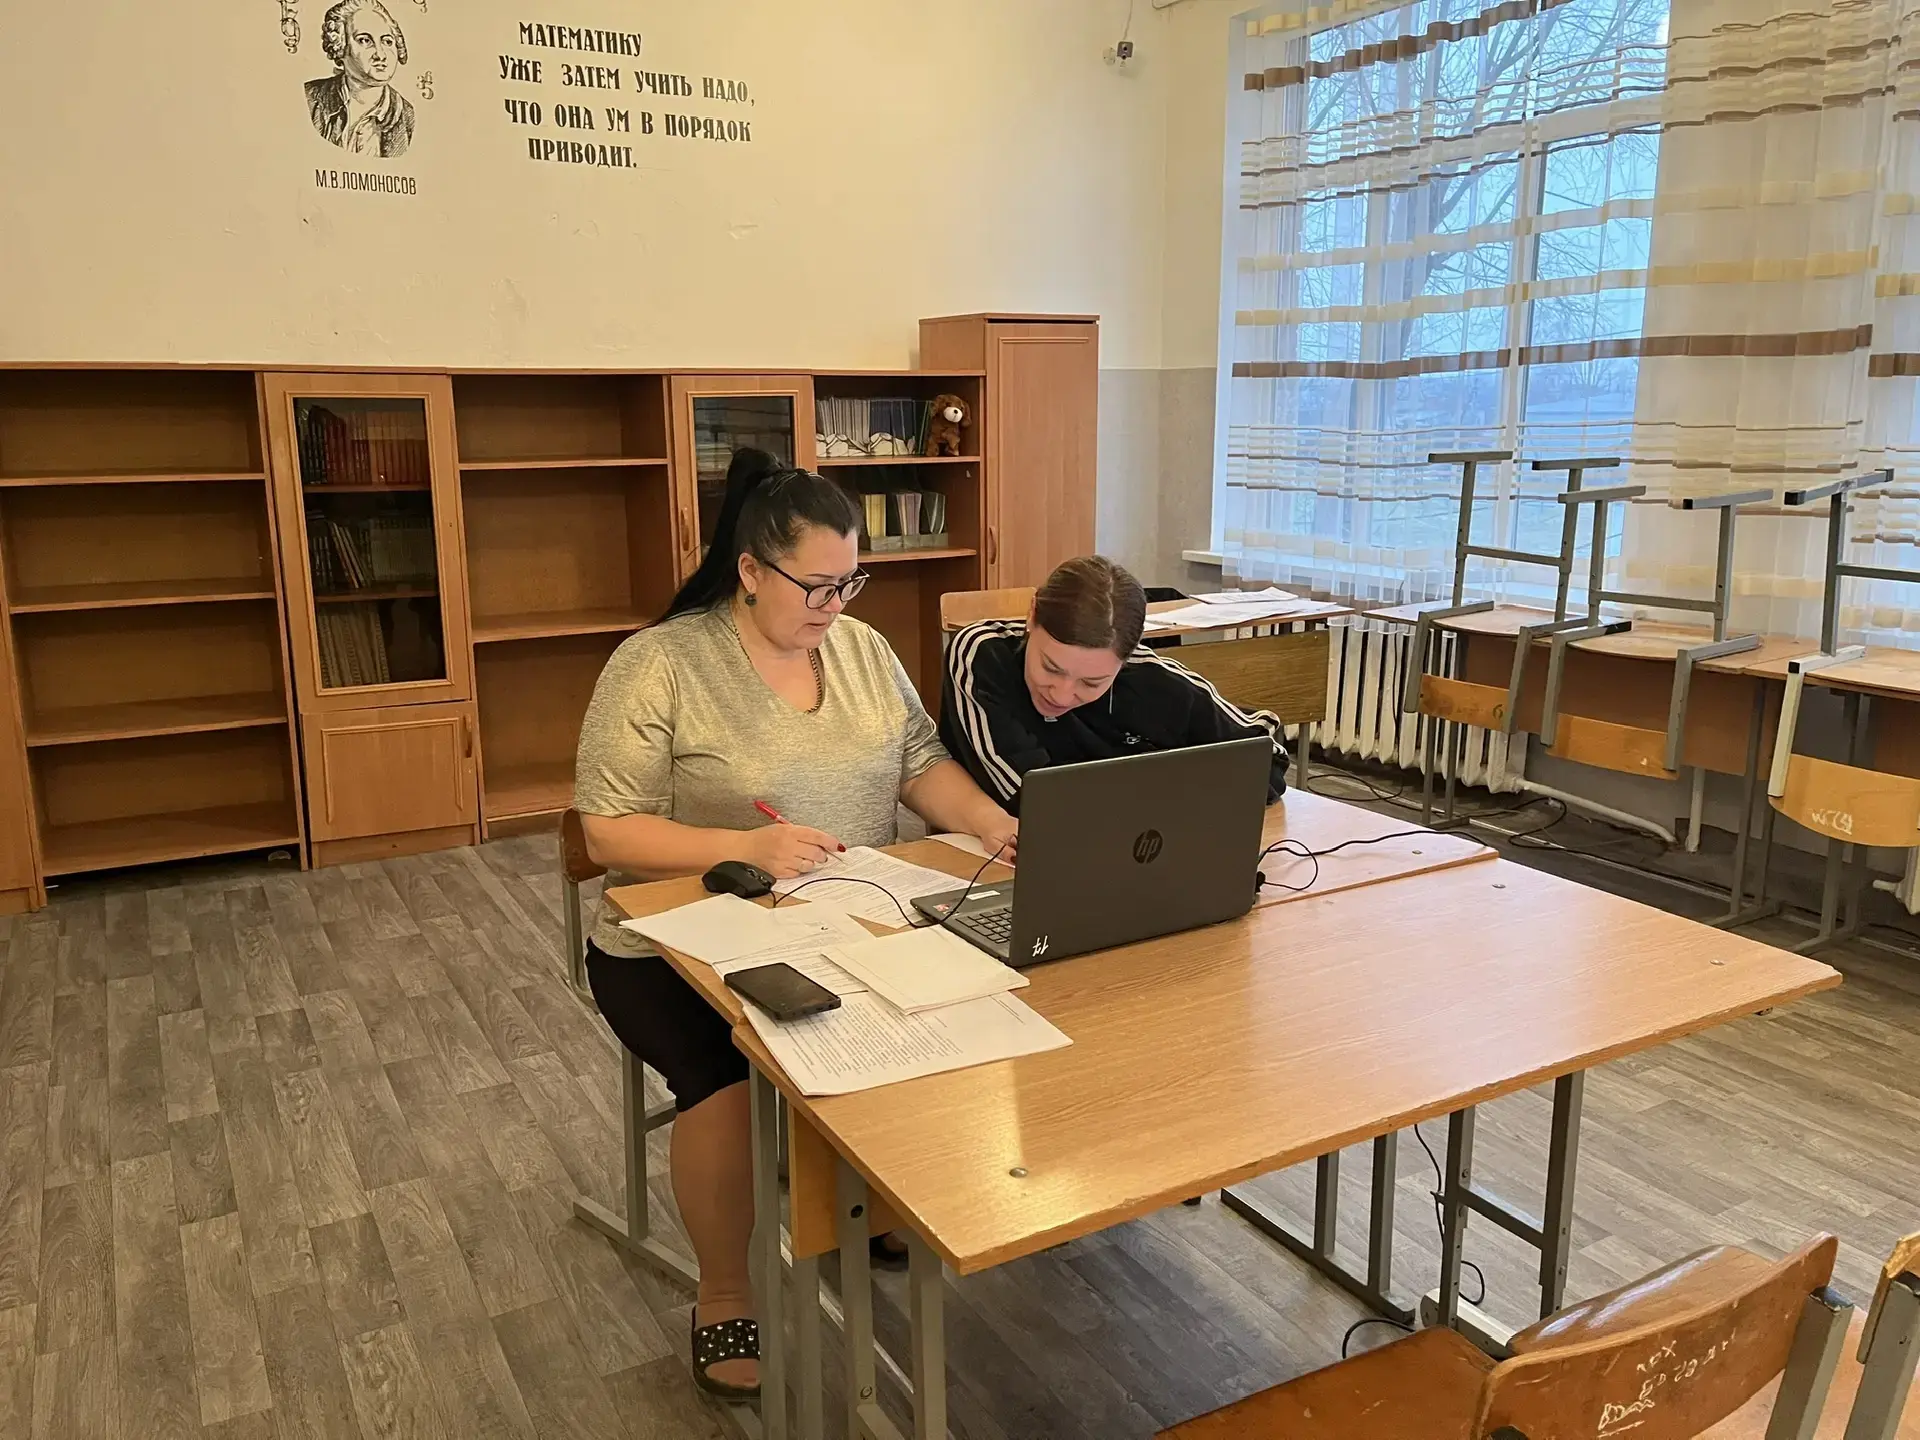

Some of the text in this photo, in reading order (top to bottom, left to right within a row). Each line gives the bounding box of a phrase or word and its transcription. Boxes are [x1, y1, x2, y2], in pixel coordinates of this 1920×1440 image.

[518, 21, 642, 57] МАТЕМАТИКУ
[498, 54, 755, 107] УЖЕ ЗАТЕМ УЧИТЬ НАДО,
[504, 98, 752, 143] ЧТО ОНА УМ В ПОРЯДОК
[528, 137, 638, 168] ПРИВОДИТ.
